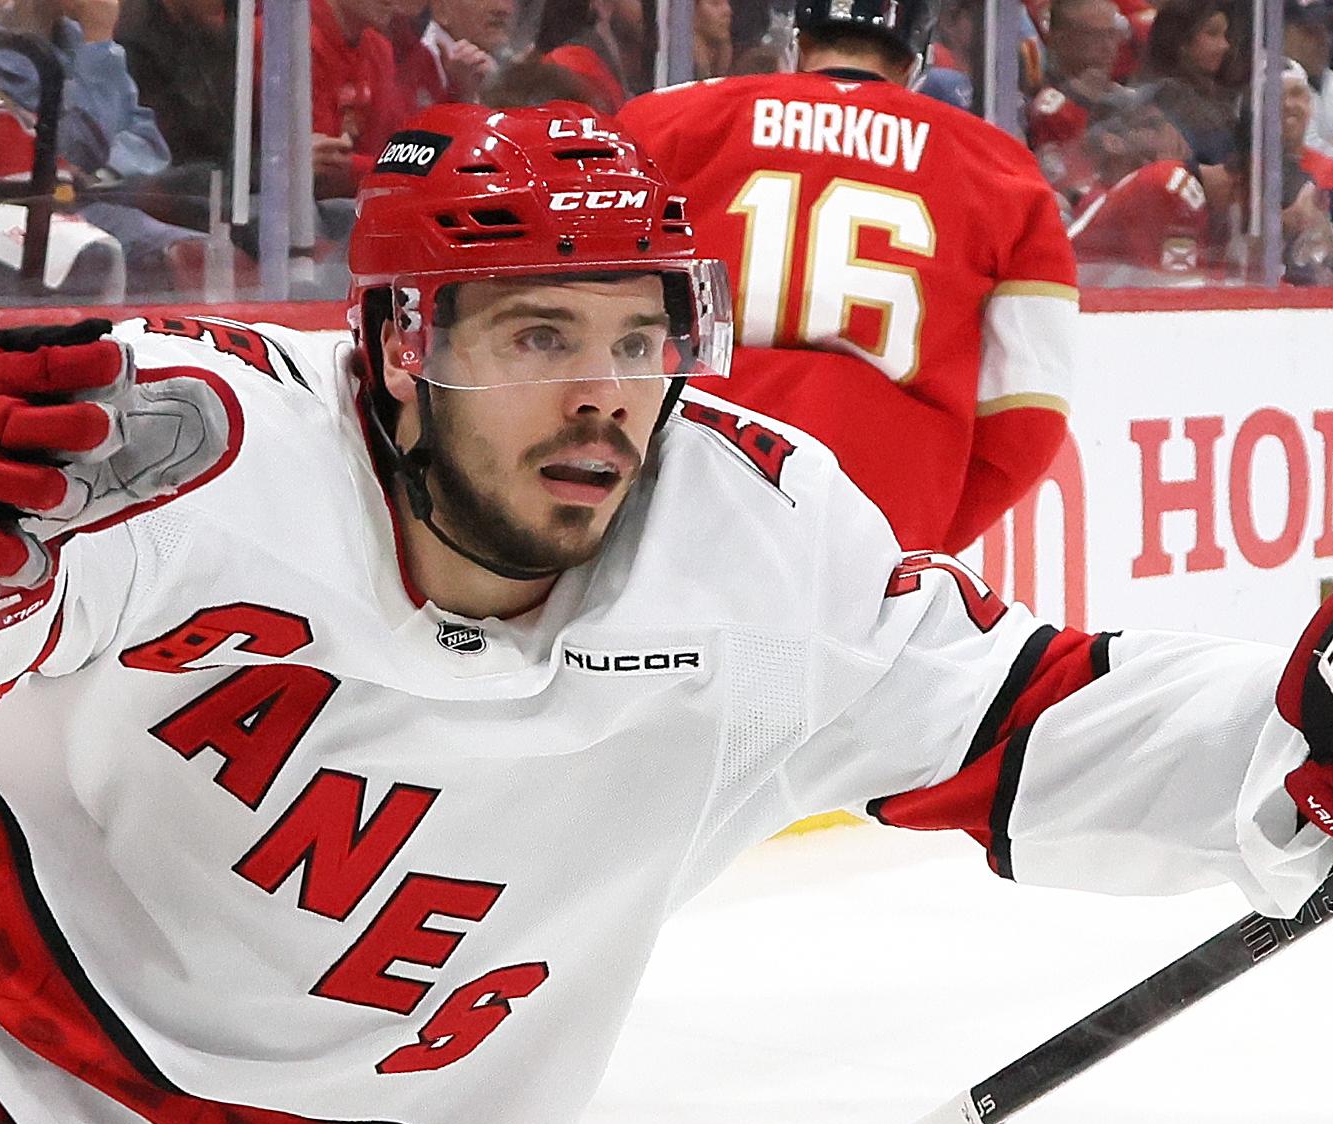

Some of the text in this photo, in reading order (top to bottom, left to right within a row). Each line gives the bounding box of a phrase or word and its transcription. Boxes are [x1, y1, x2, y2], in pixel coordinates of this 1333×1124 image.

[752, 98, 930, 172] BARKOV
[377, 141, 435, 165] Lenovo
[548, 189, 648, 211] CCM
[727, 169, 936, 383] 16
[447, 631, 478, 646] NHL
[564, 649, 700, 672] NUCOR
[118, 601, 549, 1075] CANES
